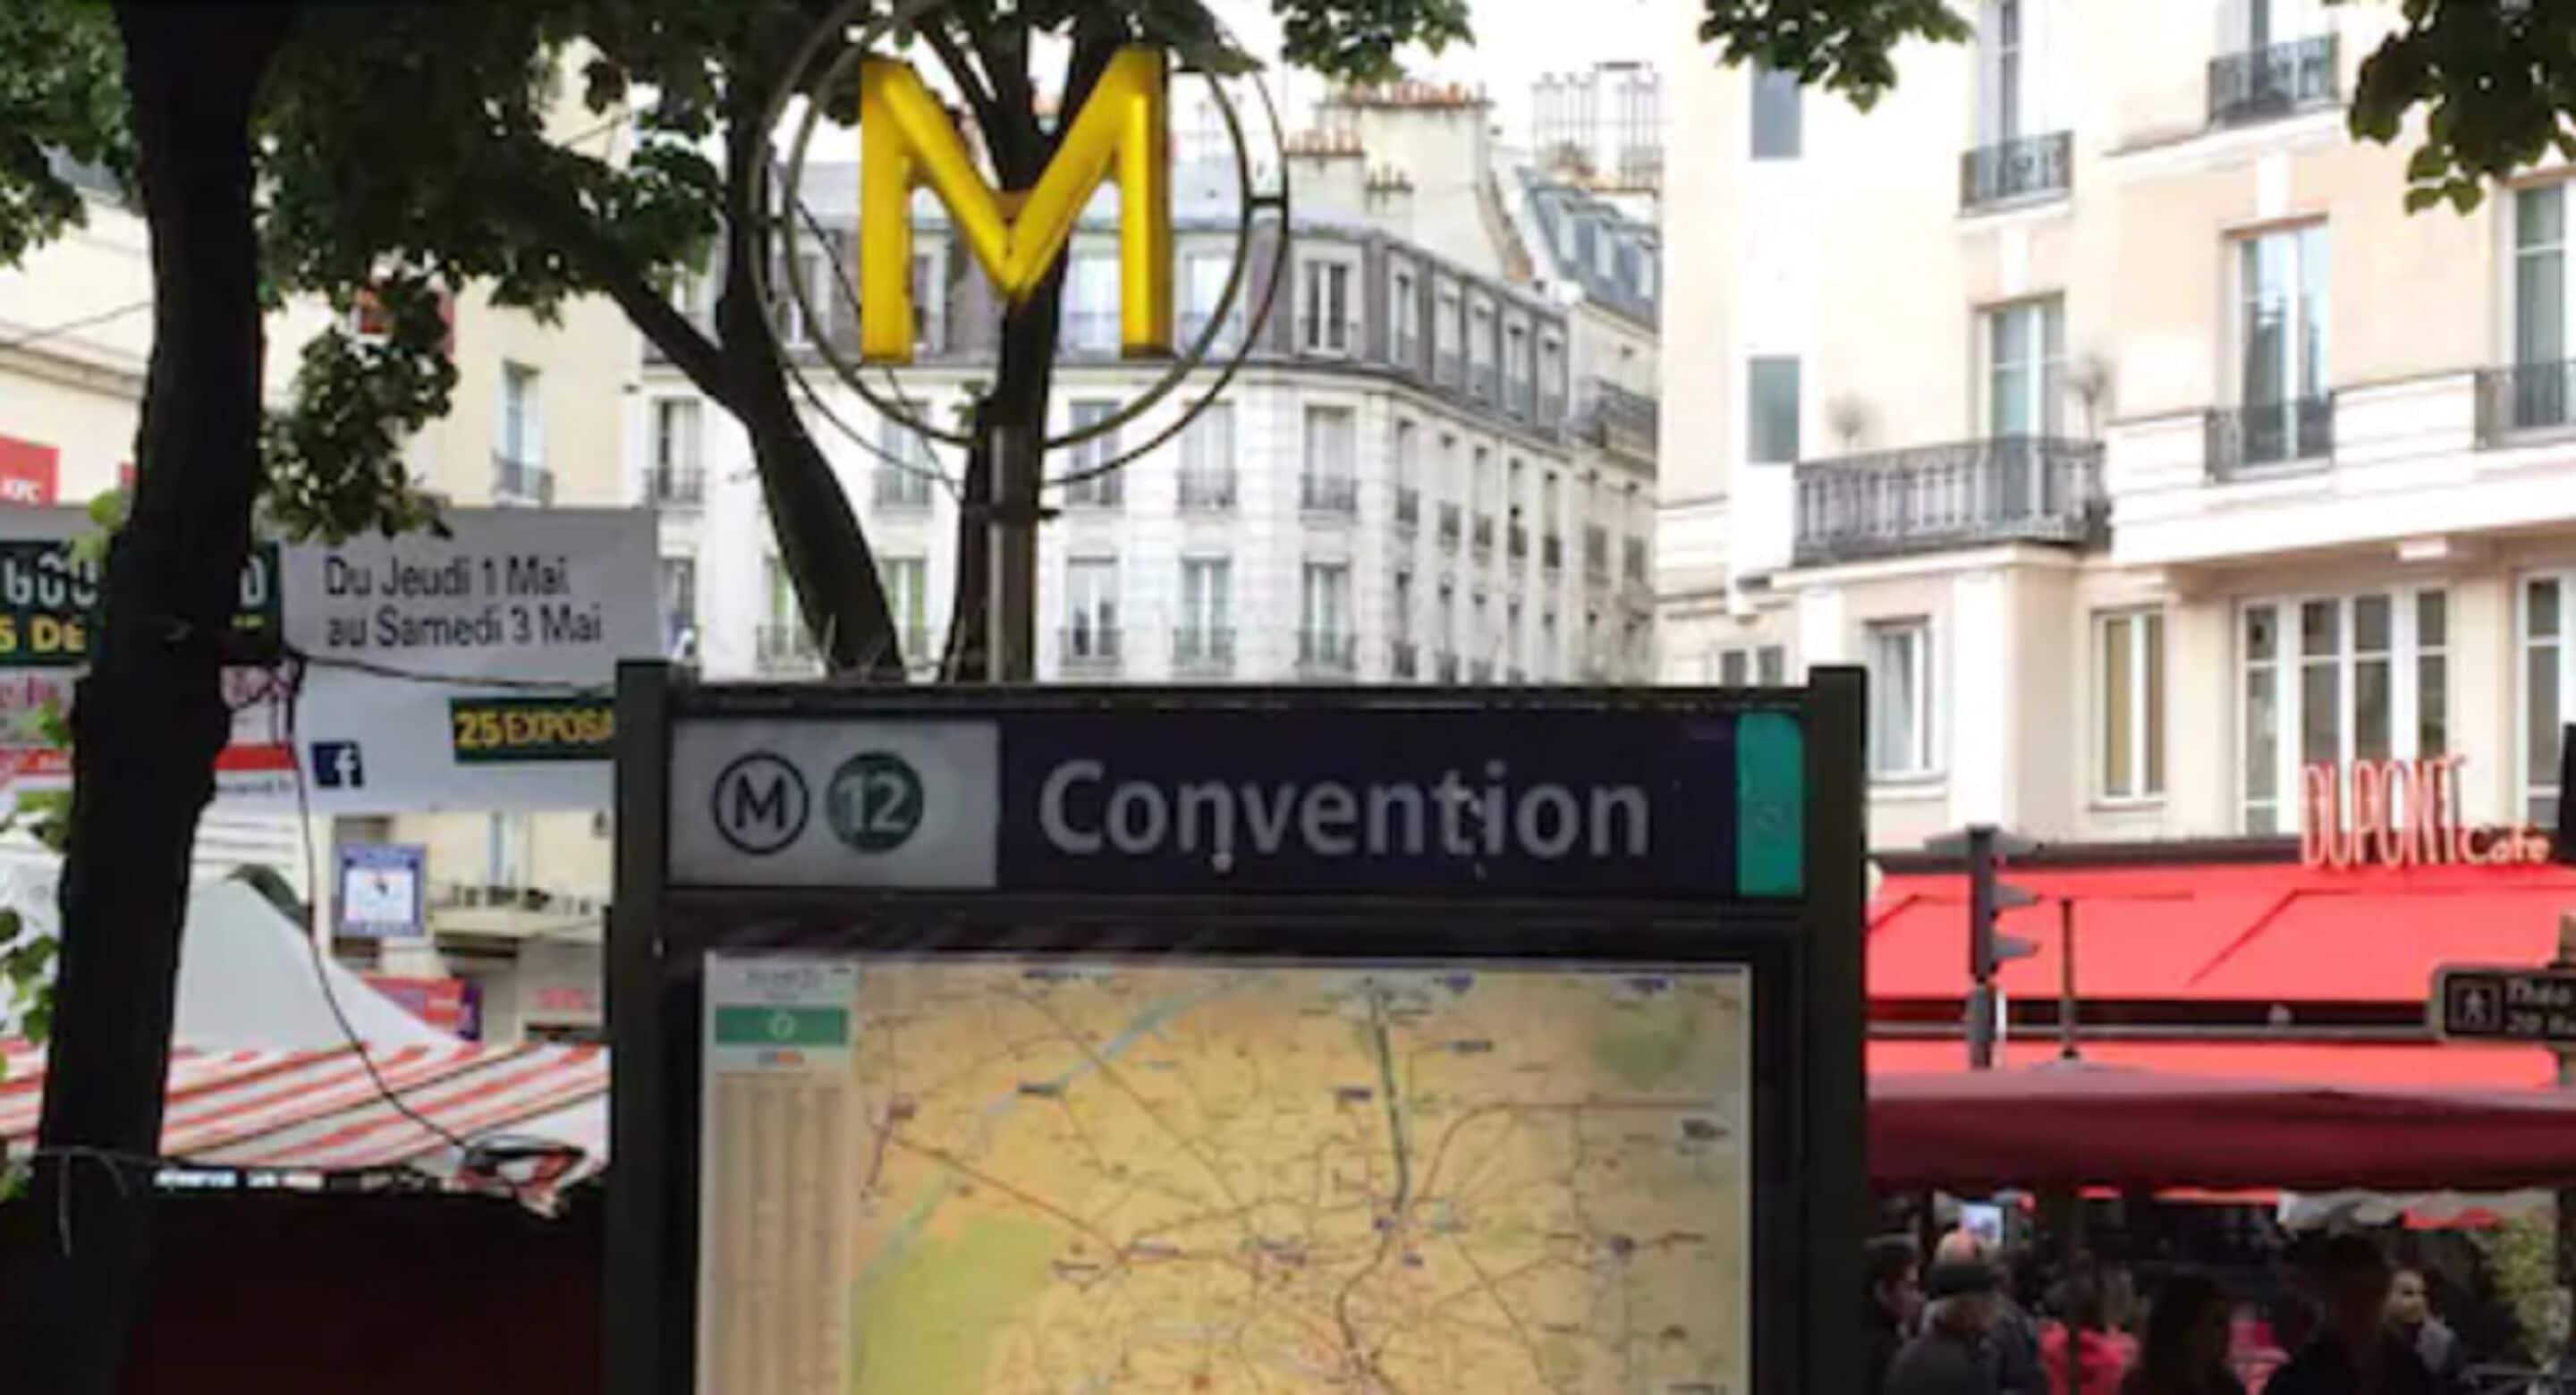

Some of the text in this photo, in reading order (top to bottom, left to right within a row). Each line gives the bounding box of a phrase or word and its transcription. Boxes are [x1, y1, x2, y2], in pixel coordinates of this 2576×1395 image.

[860, 47, 1174, 363] M
[325, 554, 570, 596] Du Jeudi 1 Mai
[327, 603, 602, 647] au Samedi 3 Mai
[733, 771, 909, 833] M 12
[1038, 758, 1650, 858] Convention
[2299, 755, 2467, 866] DUPONT
